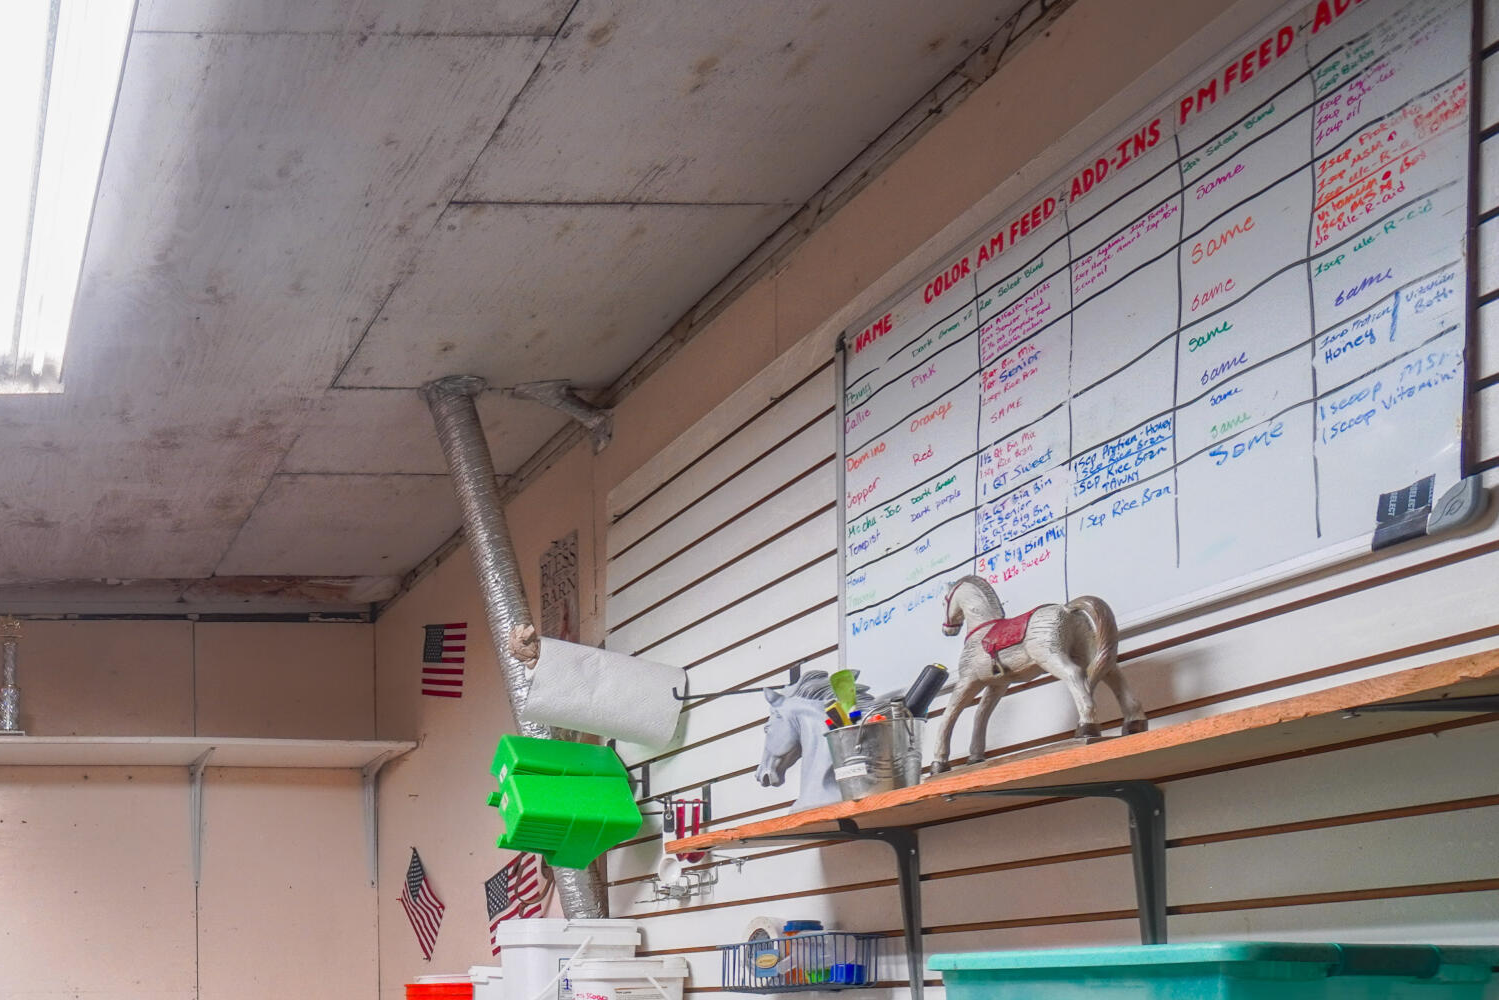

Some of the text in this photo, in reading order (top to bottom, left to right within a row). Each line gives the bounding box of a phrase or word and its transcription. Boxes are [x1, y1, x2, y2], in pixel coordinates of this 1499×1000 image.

[855, 313, 893, 353] NAME
[924, 257, 971, 304] COLOR
[977, 232, 1004, 268] AM
[1010, 197, 1057, 246] FEED
[1068, 121, 1162, 203] ADD-INS
[1179, 76, 1219, 125] PM
[1224, 26, 1294, 96] FEED
[1324, 327, 1377, 365] Honey
[845, 383, 871, 407] Penny
[912, 338, 933, 358] Dark
[999, 350, 1041, 383] Senior
[845, 409, 872, 434] Callie
[990, 398, 1022, 423] SAME
[846, 401, 953, 473] Domino Orange
[912, 445, 934, 466] Red
[1011, 448, 1052, 481] Sweet
[1102, 469, 1139, 492] TAWNY
[910, 506, 931, 523] Dark
[851, 606, 896, 636] Wonder
